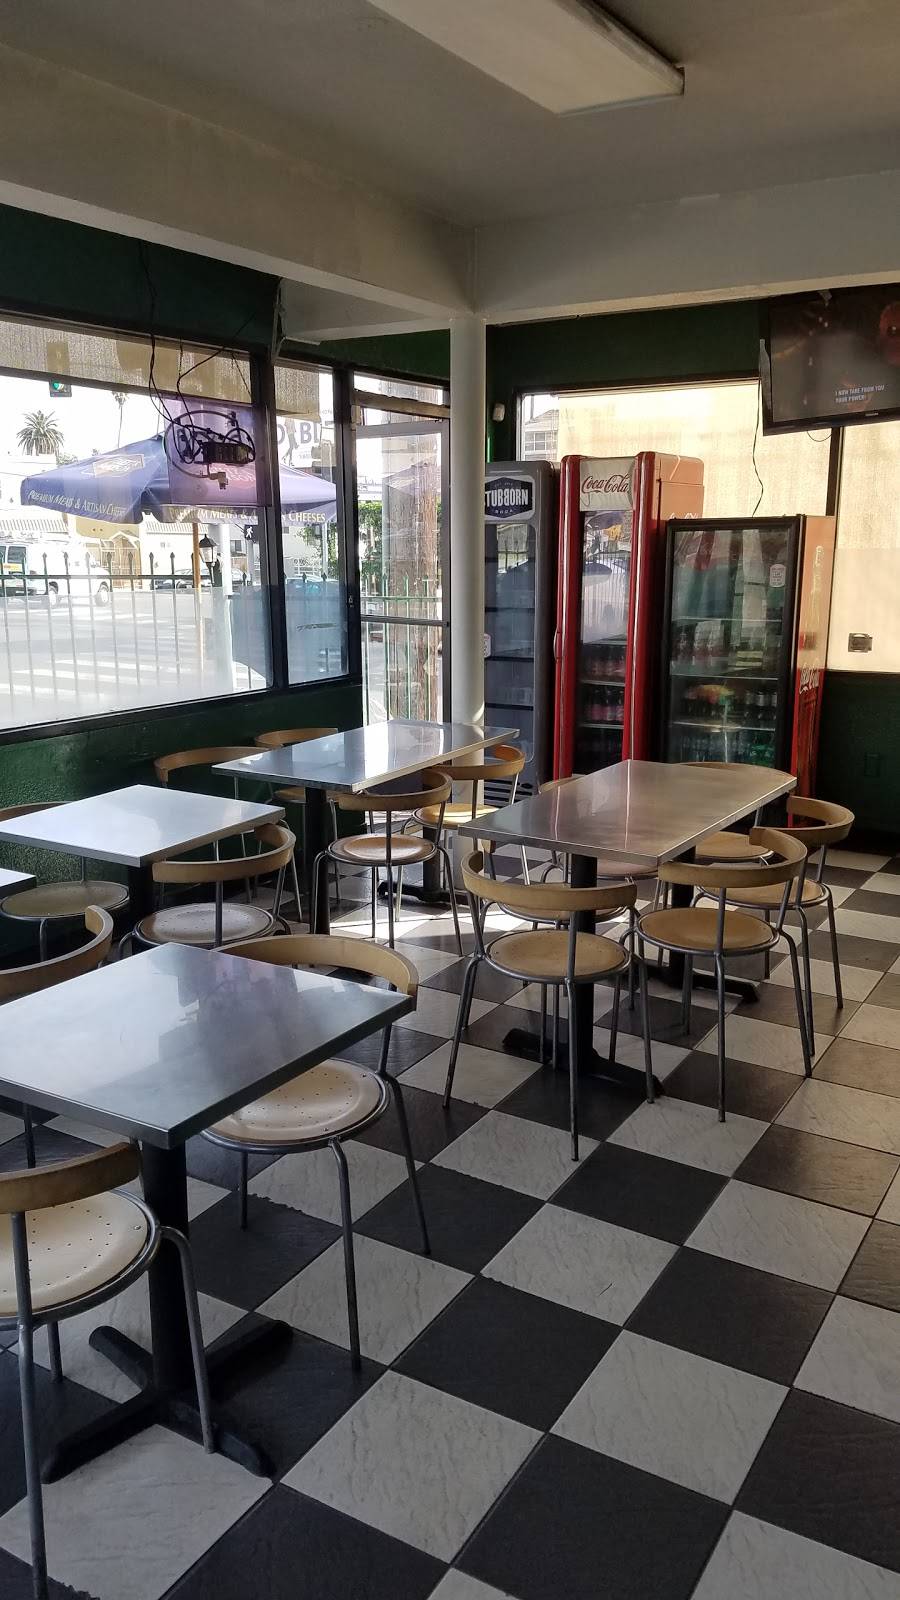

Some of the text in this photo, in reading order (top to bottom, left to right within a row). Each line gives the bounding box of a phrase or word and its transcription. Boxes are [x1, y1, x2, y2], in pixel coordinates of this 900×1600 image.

[581, 473, 630, 494] Coca-Cola
[74, 498, 81, 509] &
[486, 488, 529, 508] TUBBORN
[288, 509, 326, 522] CHEESES
